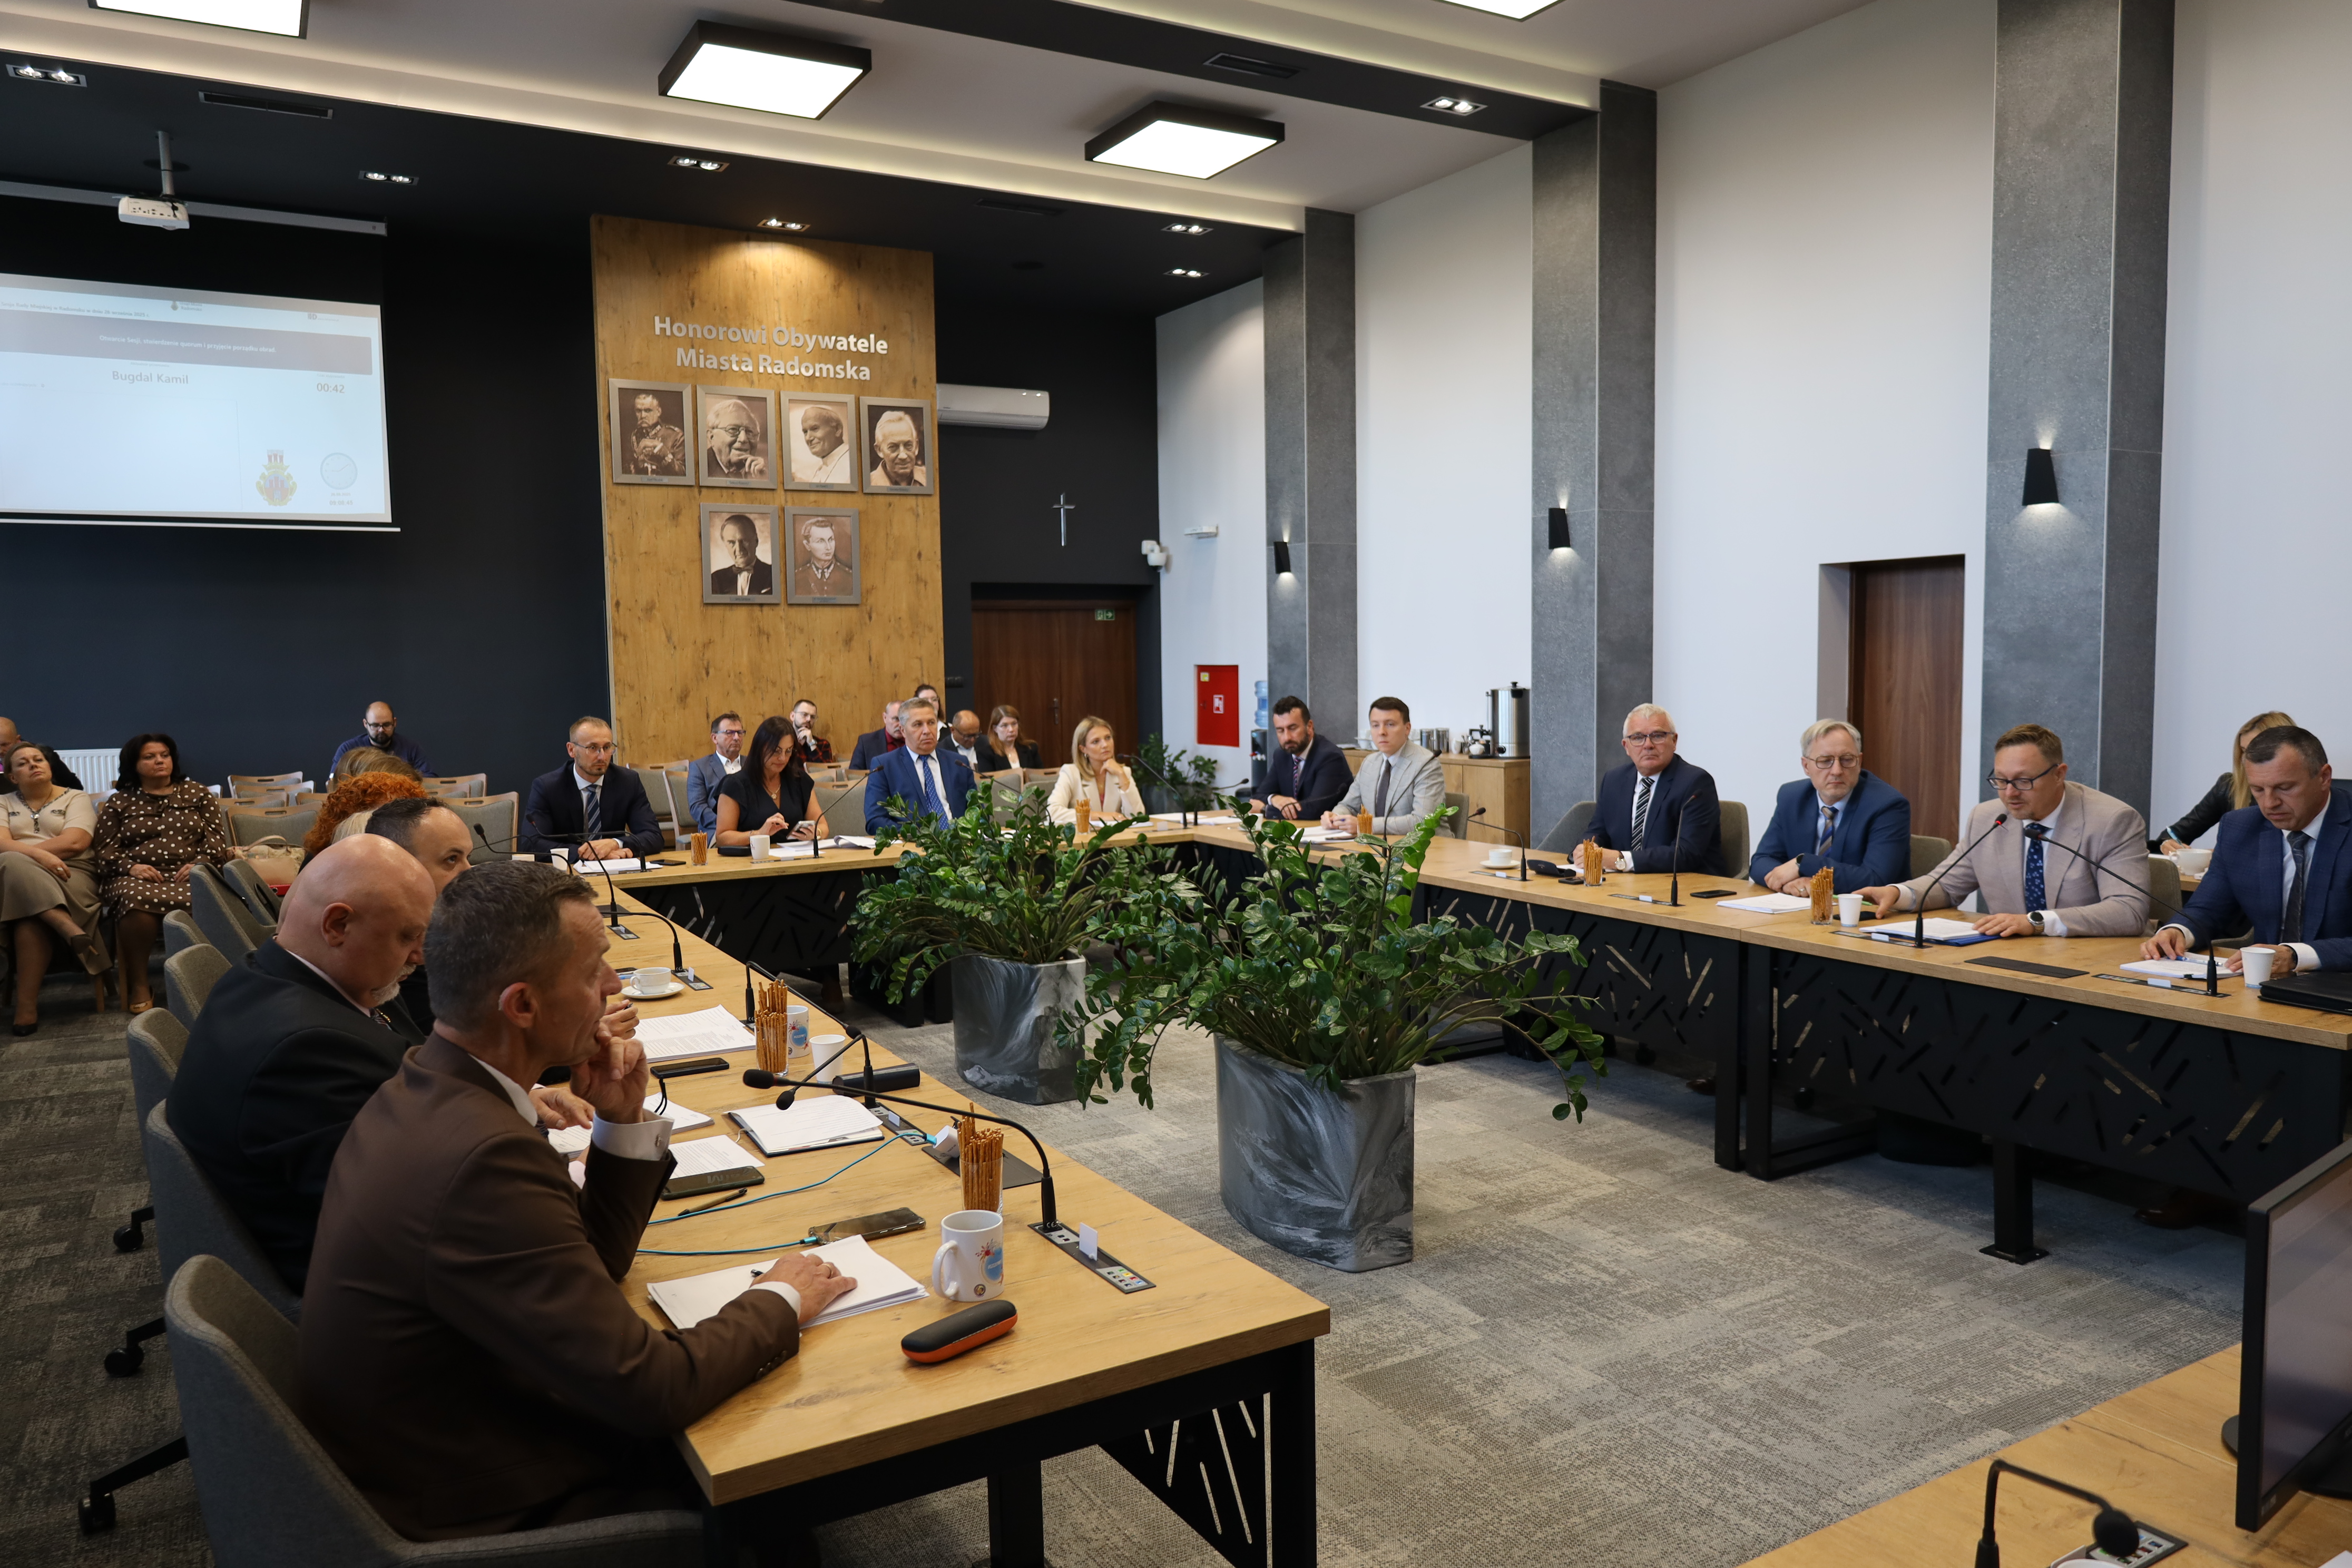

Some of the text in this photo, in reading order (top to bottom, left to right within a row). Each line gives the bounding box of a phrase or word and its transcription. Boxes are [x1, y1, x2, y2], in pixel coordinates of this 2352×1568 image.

[654, 316, 888, 354] Honorowi Obywatele
[677, 347, 870, 381] Miasta Radomska
[112, 370, 189, 384] Bugdal Kamil
[317, 383, 345, 394] 00:42
